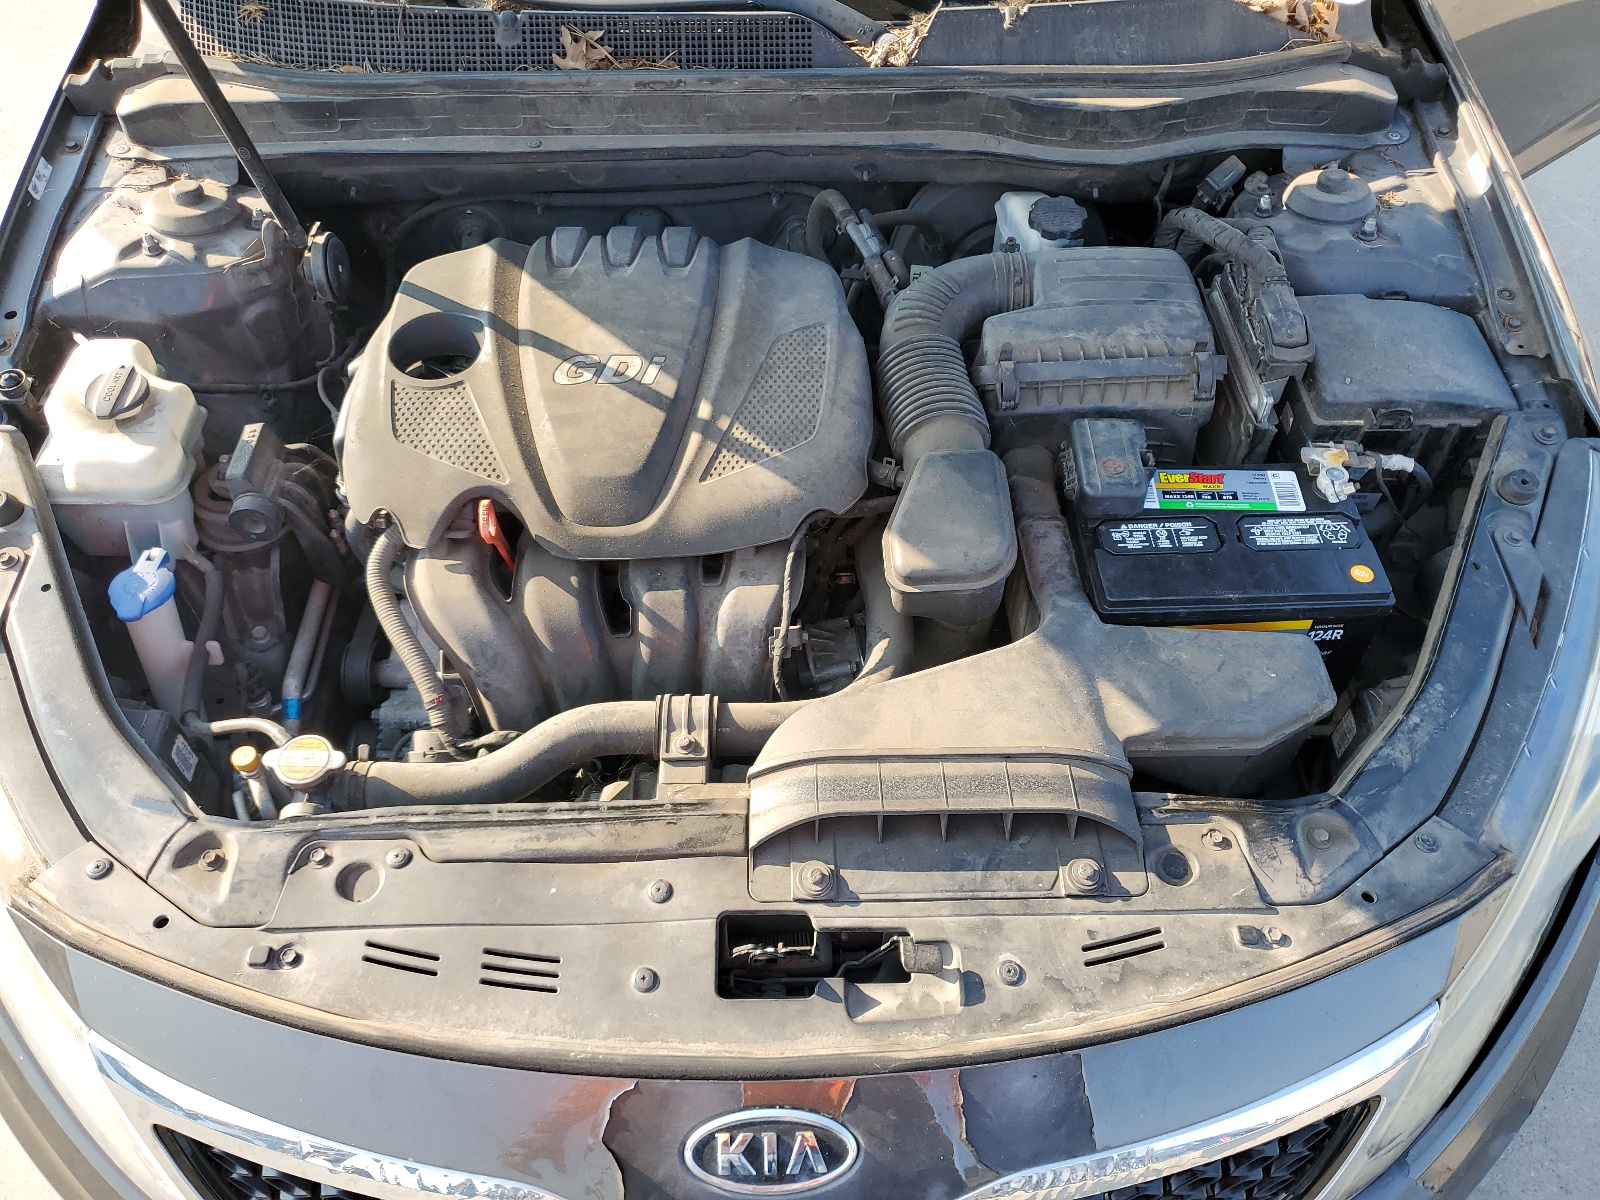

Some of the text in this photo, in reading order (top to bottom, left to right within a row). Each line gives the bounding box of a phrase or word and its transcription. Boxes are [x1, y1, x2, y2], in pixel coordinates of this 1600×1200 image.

[553, 354, 667, 385] GDi
[103, 372, 122, 402] COOLANT
[1159, 472, 1225, 484] EverStart
[1308, 629, 1344, 641] 124R
[715, 1131, 828, 1176] KIA
